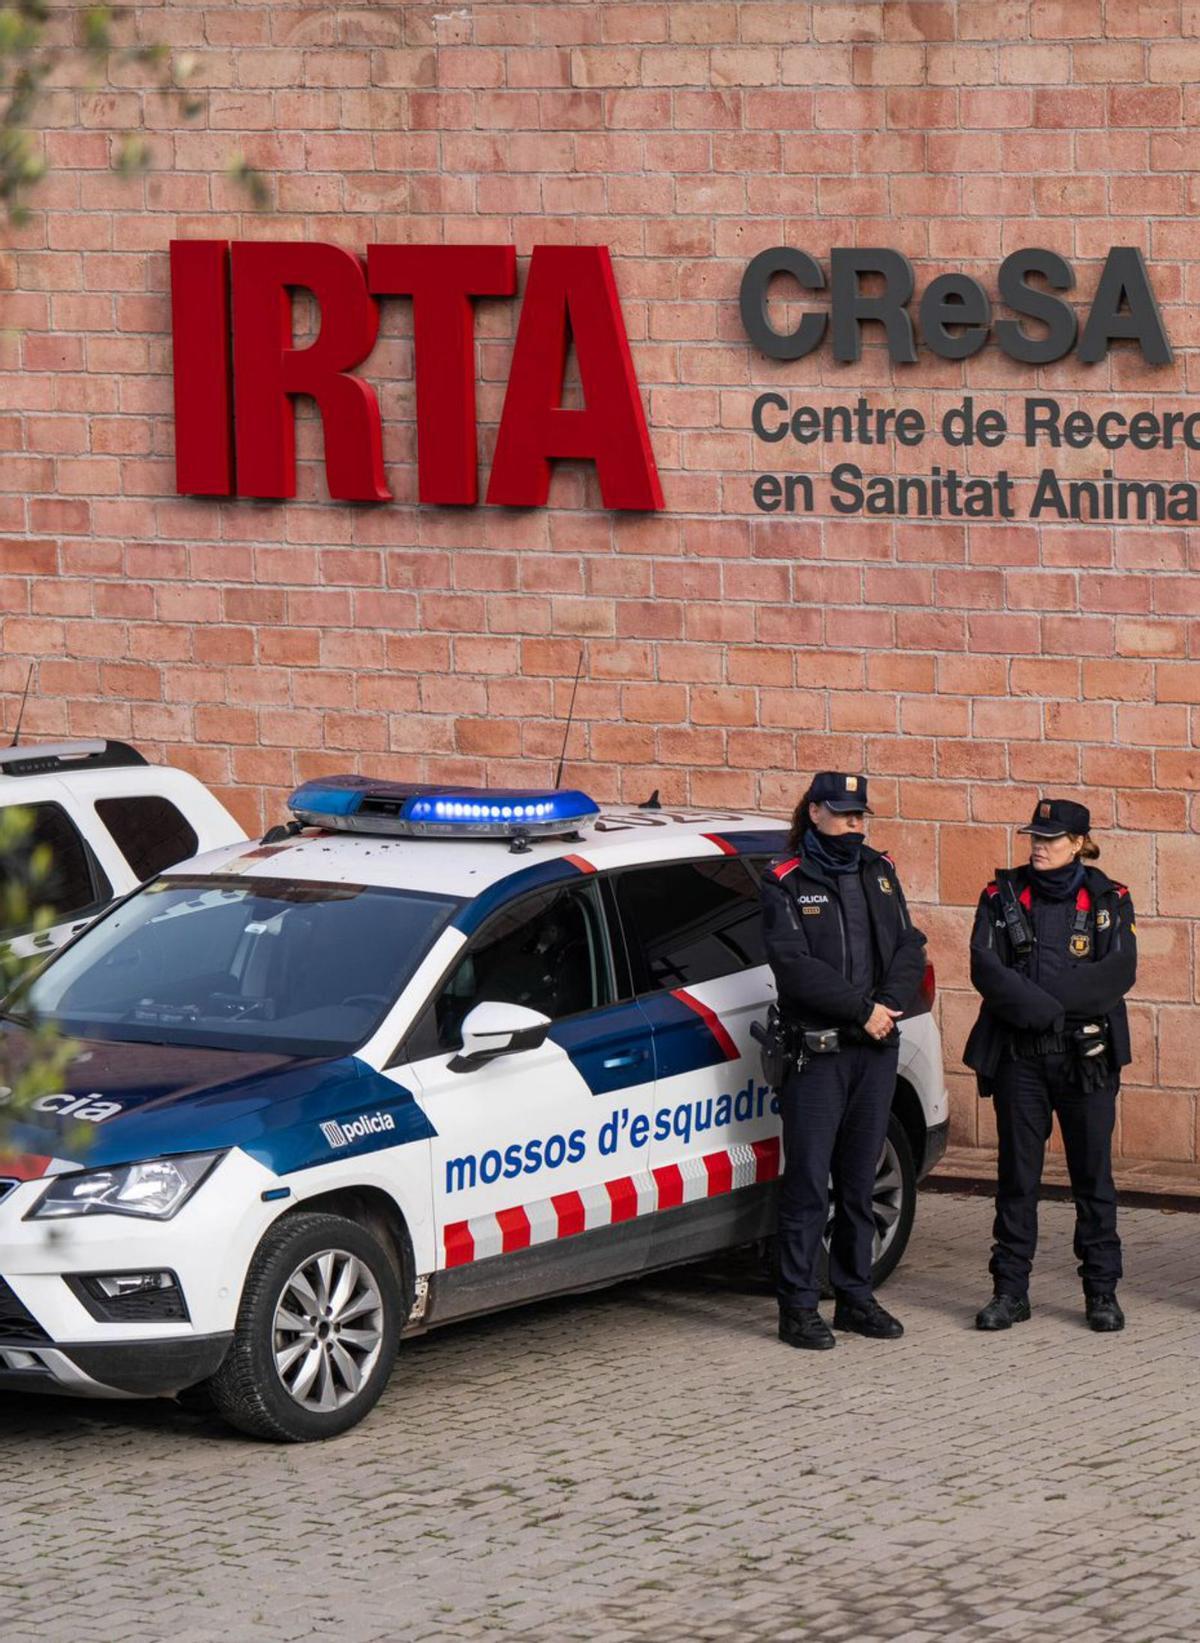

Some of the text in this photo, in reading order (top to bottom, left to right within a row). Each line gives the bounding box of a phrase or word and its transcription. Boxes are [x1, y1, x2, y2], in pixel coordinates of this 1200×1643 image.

[740, 246, 1174, 364] CReSA
[170, 239, 665, 511] IRTA
[751, 391, 926, 447] Centre
[942, 397, 1006, 447] de
[753, 463, 1198, 521] en Sanitat Anima
[341, 1111, 395, 1142] policia
[445, 1128, 586, 1194] mossos
